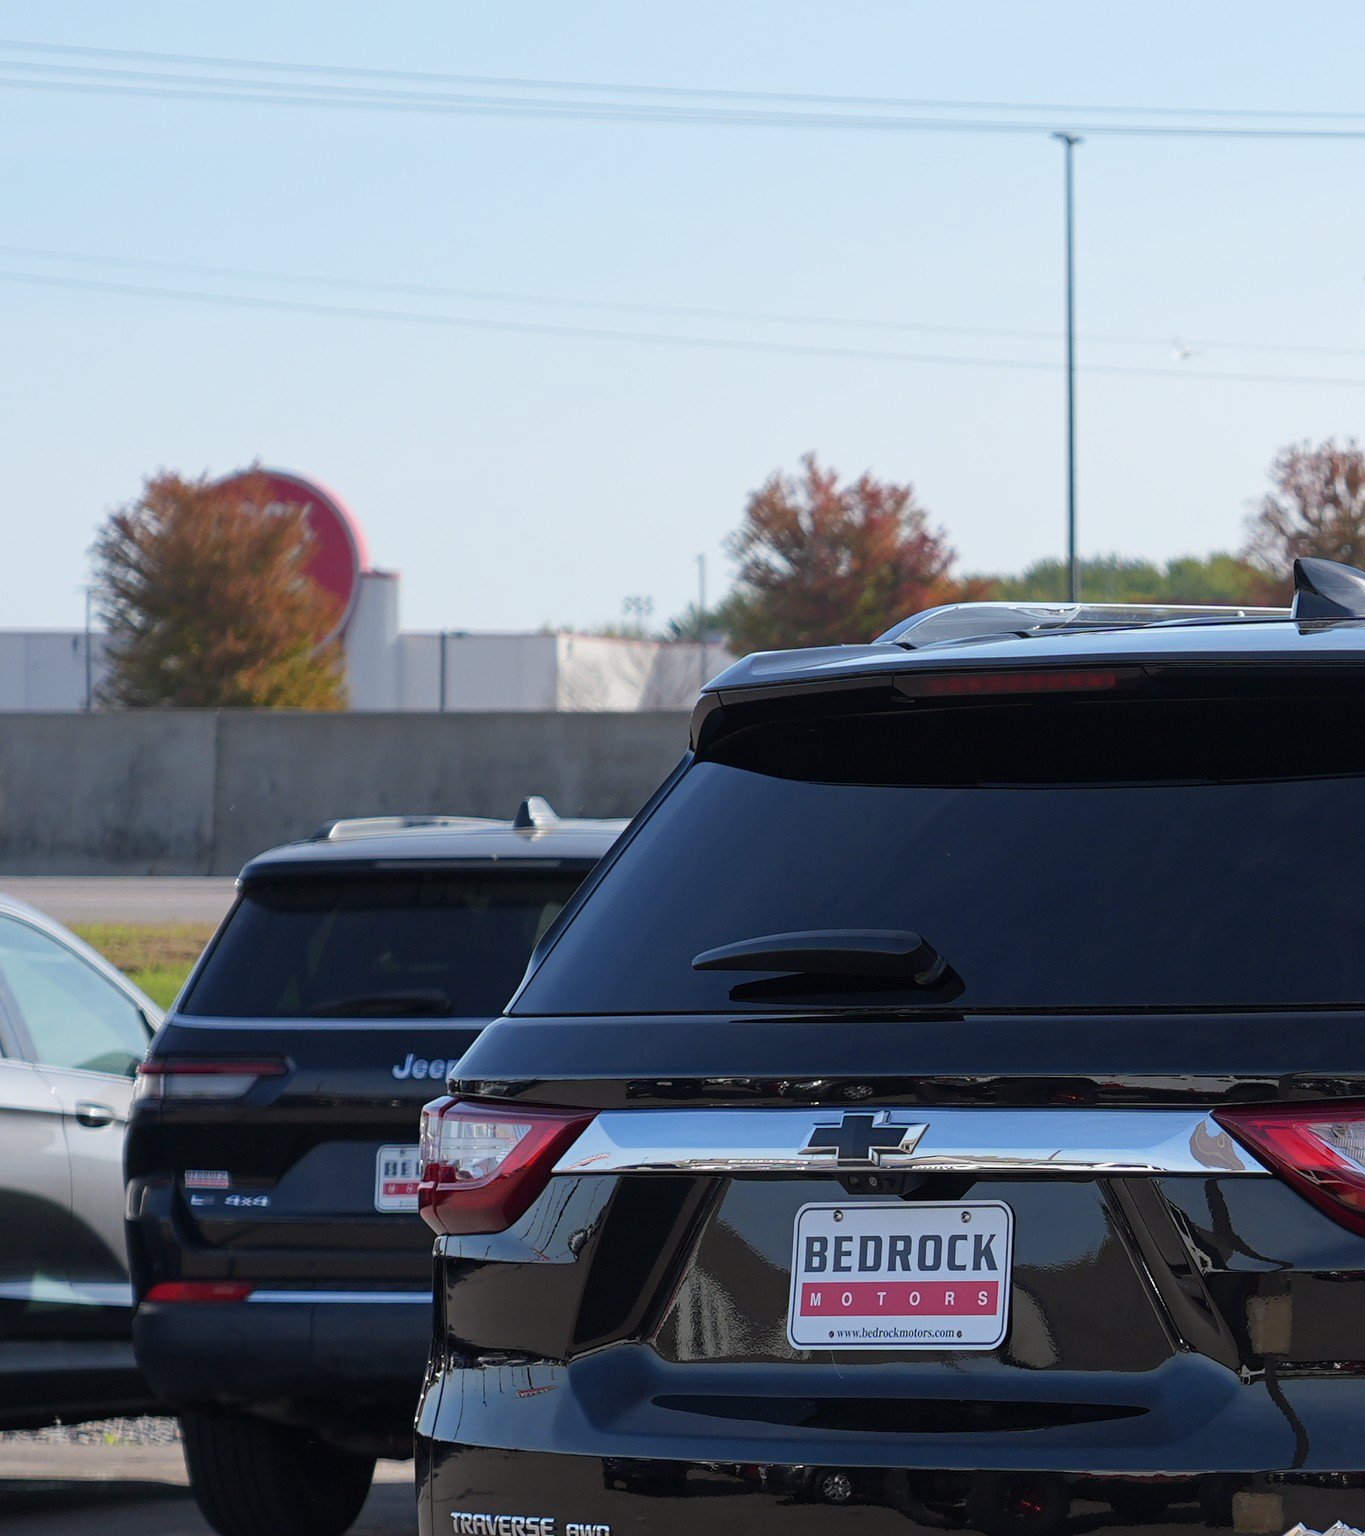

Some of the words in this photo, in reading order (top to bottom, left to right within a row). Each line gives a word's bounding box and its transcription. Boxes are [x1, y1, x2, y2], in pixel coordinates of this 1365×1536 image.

[803, 1233, 998, 1273] BEDROCK
[810, 1291, 988, 1306] MOTORS
[836, 1327, 955, 1340] www.bedrockmotors.com
